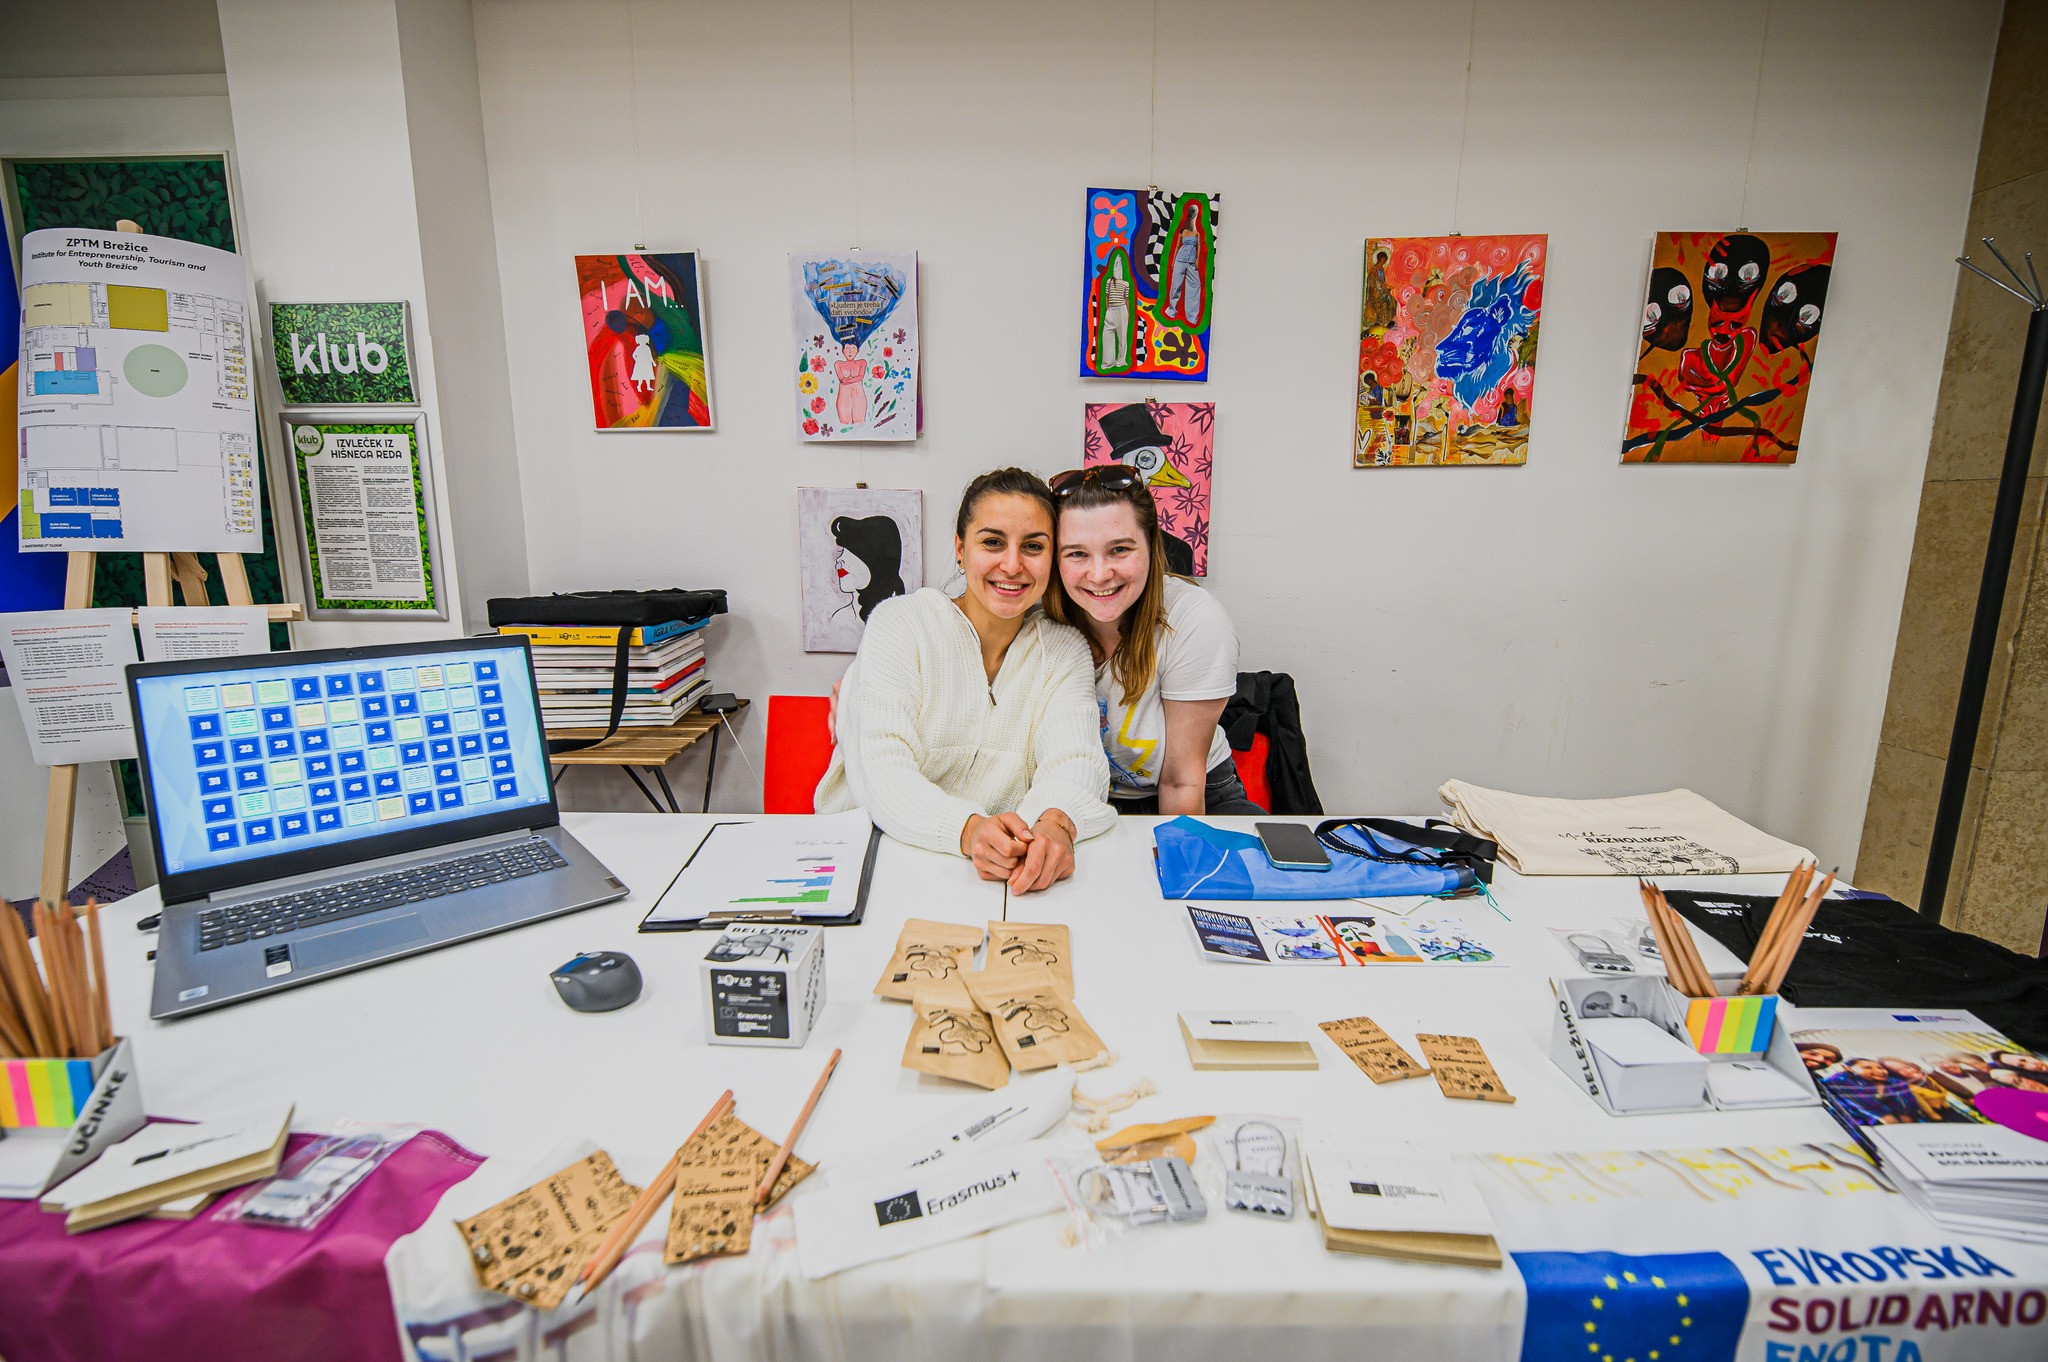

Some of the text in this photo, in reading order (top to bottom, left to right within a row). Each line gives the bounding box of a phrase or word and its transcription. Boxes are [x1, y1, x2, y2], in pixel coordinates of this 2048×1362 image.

[66, 238, 149, 252] ZPTM Brežice
[31, 250, 206, 272] Institute for Entrepreneurship, Tourism and
[78, 260, 138, 271] Youth Brežice
[601, 280, 608, 311] I
[856, 302, 863, 310] je
[290, 332, 388, 375] klub
[297, 433, 319, 445] klub
[336, 436, 394, 450] IZVLEČEK IZ
[331, 446, 403, 460] HIŠNEGA REDA
[654, 627, 669, 637] IGRA
[1585, 835, 1687, 843] RAZNOLIKOSTI
[732, 927, 809, 935] BELEŽIMO
[1559, 1001, 1600, 1097] BELEŽIMO
[70, 1069, 129, 1156] UČINKE
[927, 1169, 1020, 1216] Erasmus+
[1751, 1245, 2017, 1287] EVROPSKA
[1766, 1288, 2048, 1334] SOLIDARNO
[1765, 1334, 1924, 1362] ENOTA
